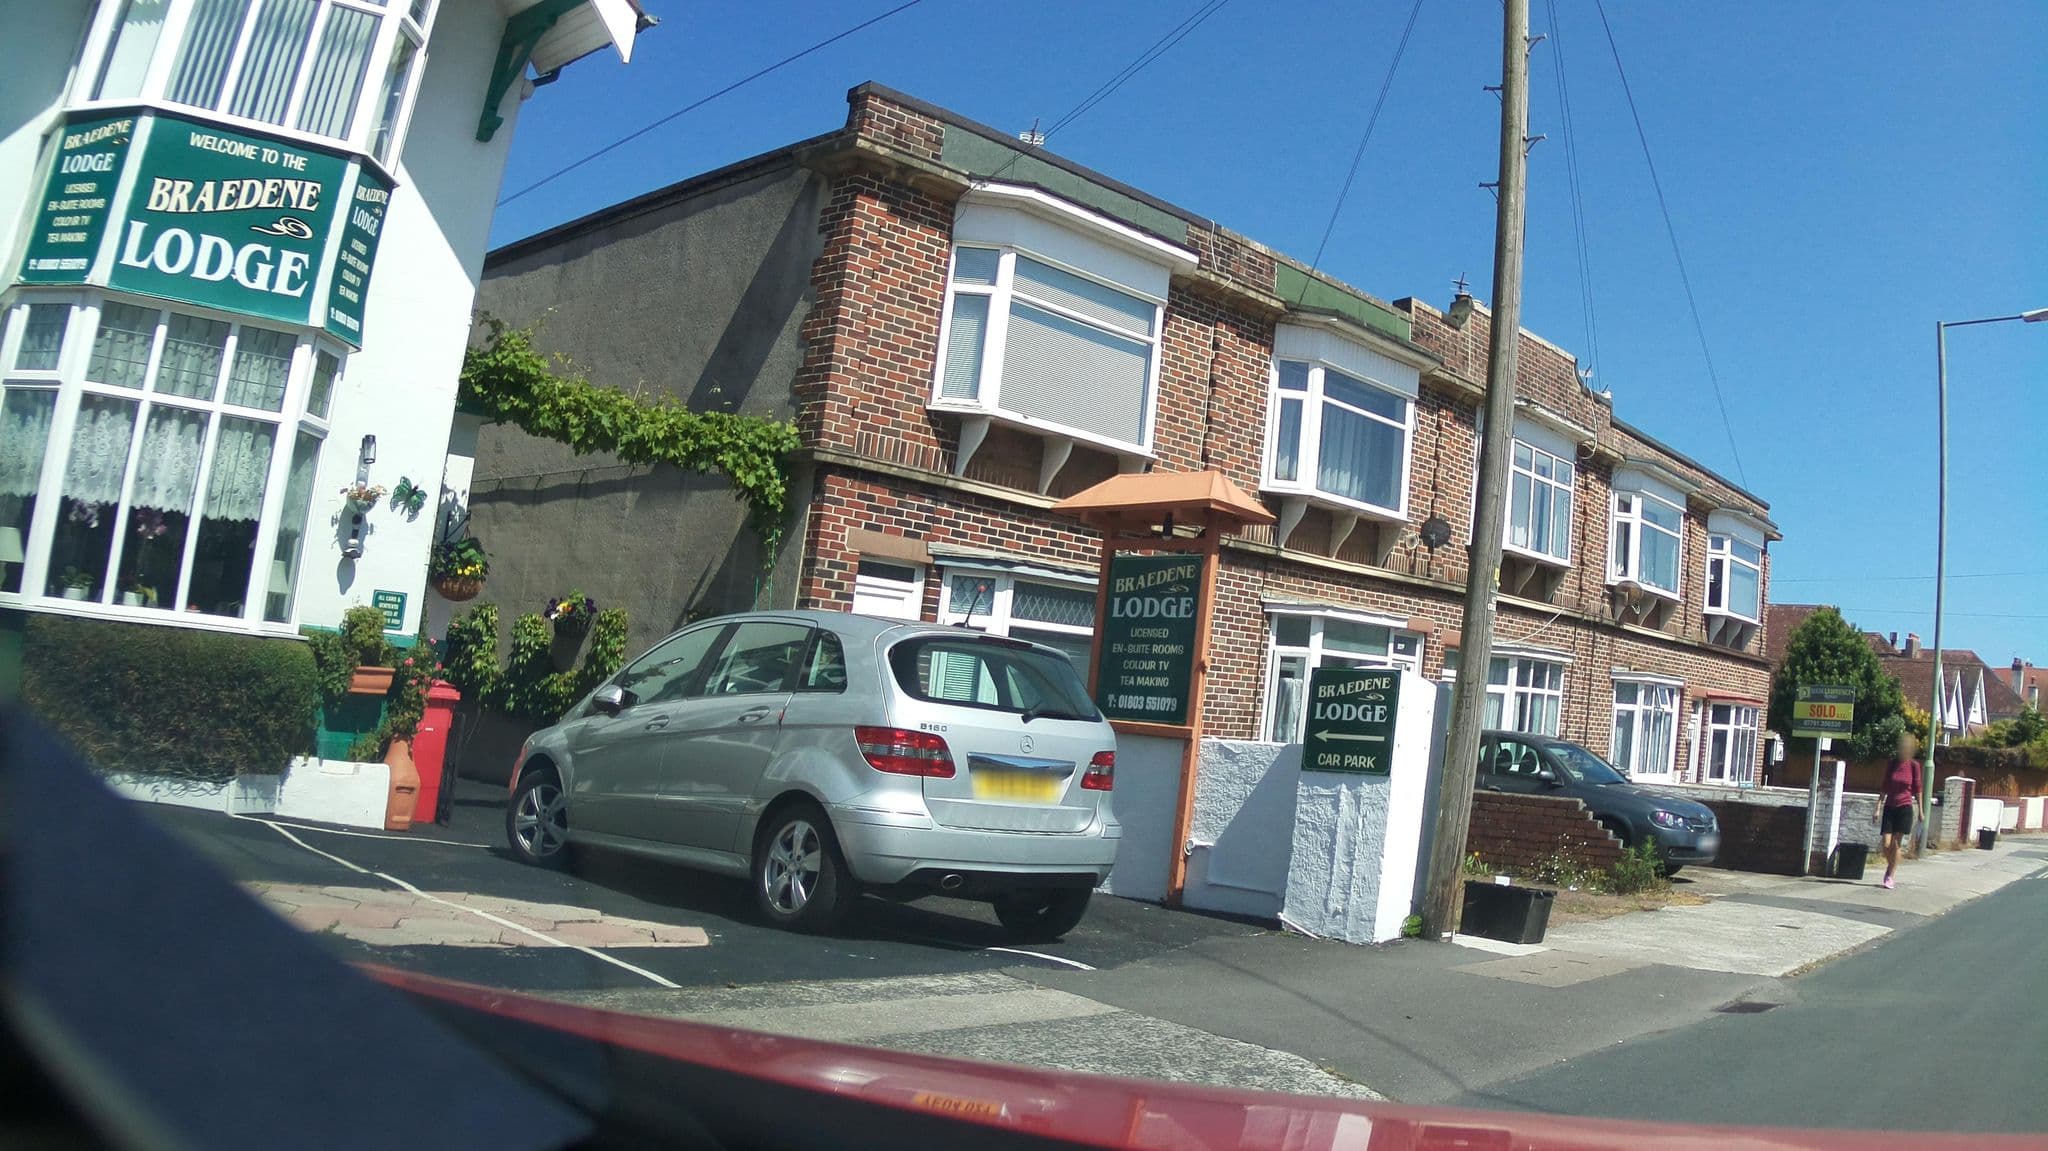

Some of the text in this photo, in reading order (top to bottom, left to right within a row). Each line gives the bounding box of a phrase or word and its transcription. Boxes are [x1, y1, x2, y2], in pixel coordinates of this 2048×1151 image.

[64, 119, 132, 150] BRAEDENE
[190, 132, 308, 172] WELCOME TO THE
[61, 153, 115, 174] LODGE
[146, 176, 322, 213] BRAEDENE
[355, 184, 389, 206] BRAEDENE
[352, 206, 380, 237] LODGE
[119, 220, 310, 298] LODGE
[1115, 565, 1196, 594] BRAEDENE
[1112, 597, 1194, 619] LODGE
[1130, 628, 1169, 639] LICENSED
[1112, 643, 1184, 655] EN-SUITE ROOMS
[1123, 659, 1170, 671] COLOUR TV
[1120, 675, 1169, 688] TEA MAKING
[1318, 677, 1391, 698] BRAEDENE
[1118, 695, 1144, 710] 01803
[1145, 696, 1178, 711] 551079
[1315, 702, 1388, 723] LODGE
[1809, 704, 1836, 718] SOLD
[1317, 753, 1376, 768] CAR PARK
